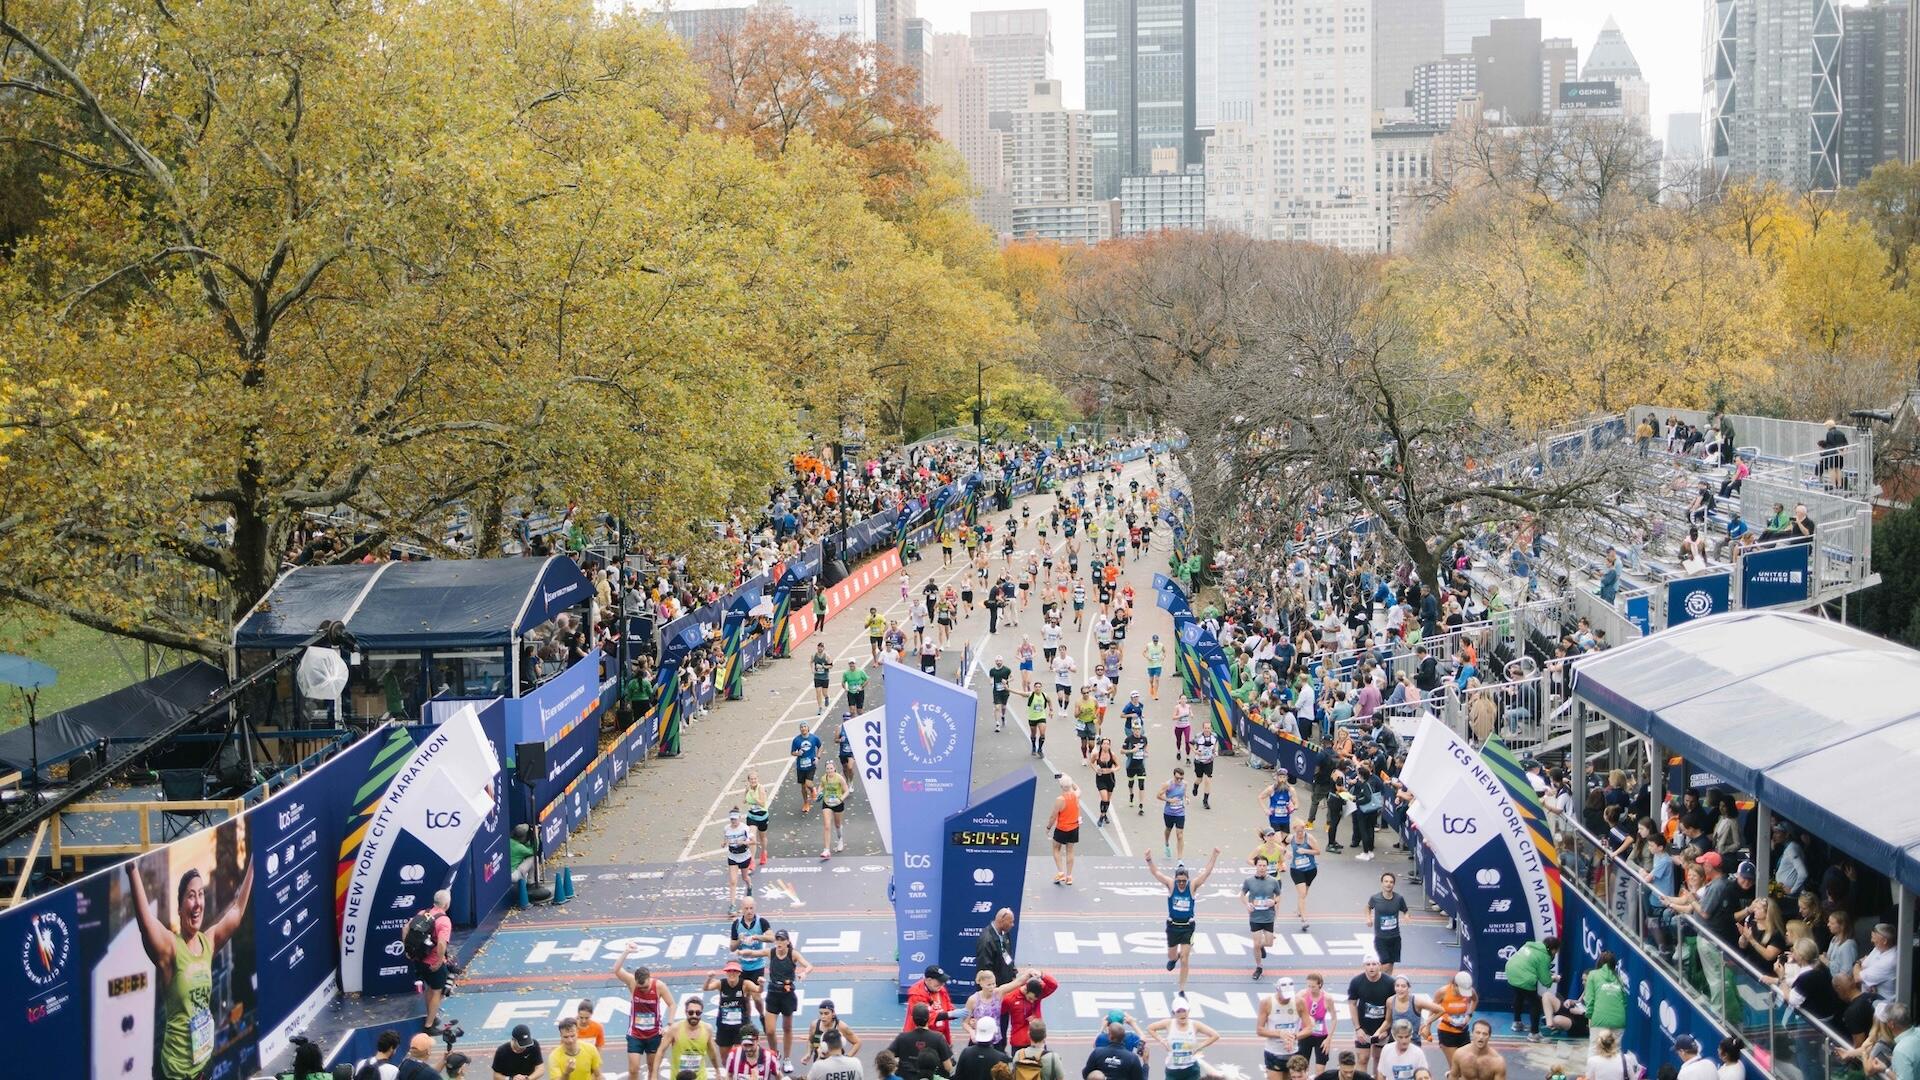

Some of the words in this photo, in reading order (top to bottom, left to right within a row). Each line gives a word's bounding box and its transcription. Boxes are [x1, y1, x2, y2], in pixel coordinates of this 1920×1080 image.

[922, 703, 940, 714] TCS
[942, 712, 957, 732] NEW
[865, 720, 882, 780] 2022
[898, 714, 924, 764] MARATHON
[945, 732, 958, 756] YORK
[389, 733, 450, 804] MARATHON
[922, 754, 943, 764] CITY
[426, 808, 461, 829] tcs
[1448, 740, 1472, 766] TCS
[1470, 765, 1500, 796] NEW
[1500, 796, 1524, 838] YORK
[1519, 840, 1541, 874] CITY
[374, 808, 392, 838] CITY
[1442, 813, 1477, 834] tcs
[357, 844, 378, 883] YORK
[904, 852, 931, 869] tcs
[349, 884, 366, 918] NEW
[41, 912, 56, 924] TCS
[56, 918, 69, 937] NEW
[344, 923, 356, 956] TCS
[524, 931, 862, 964] FNISH
[1054, 932, 1376, 956] FINISH
[1582, 917, 1604, 960] tcs
[23, 933, 42, 984] MARATHON
[59, 936, 70, 967] YORK
[42, 968, 59, 985] CITY
[379, 966, 409, 976] ESPN
[1638, 997, 1651, 1017] TATA
[826, 1070, 856, 1080] CREW
